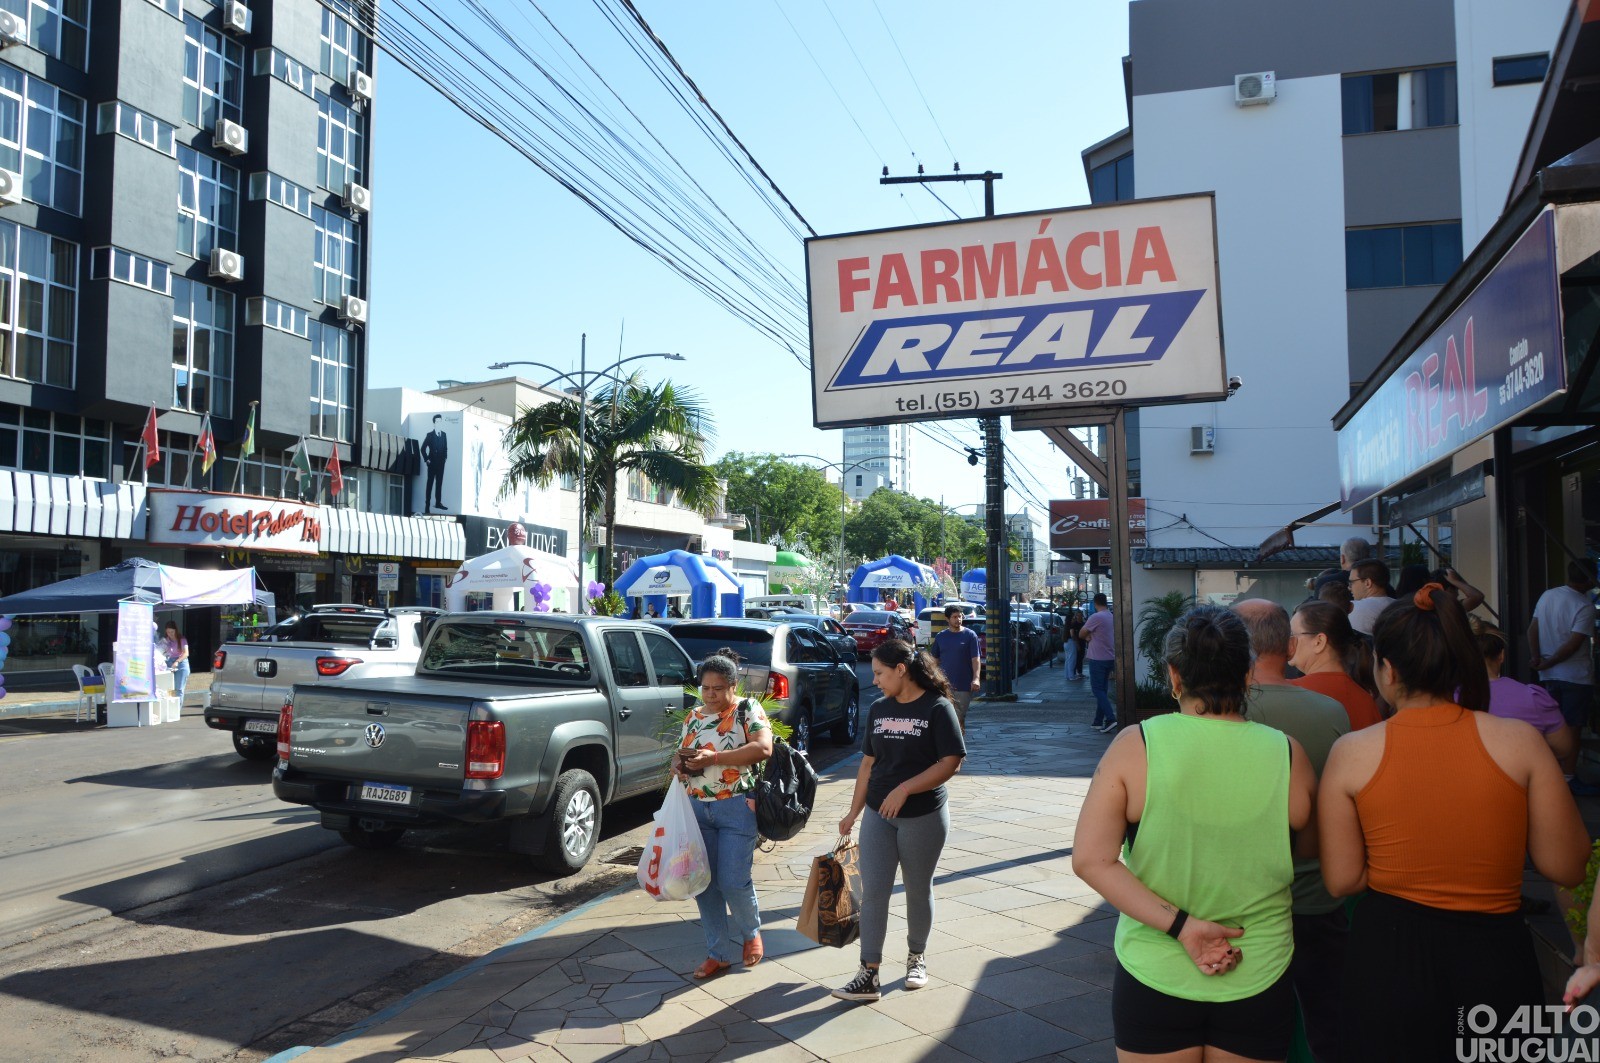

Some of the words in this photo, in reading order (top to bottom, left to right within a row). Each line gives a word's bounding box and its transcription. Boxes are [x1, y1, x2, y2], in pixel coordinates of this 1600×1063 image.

[837, 218, 1178, 313] FARMÁCIA
[858, 303, 1155, 378] REAL
[1510, 338, 1528, 366] Contato
[1405, 316, 1488, 461] REAL
[1506, 352, 1544, 401] 3744-3620
[896, 389, 980, 414] tel.(55)
[990, 387, 1053, 406] 3744
[1062, 378, 1126, 399] 3620
[169, 505, 253, 537] Hotel
[255, 509, 305, 538] Palace
[1051, 515, 1146, 534] Confiça
[487, 526, 557, 555] EXUTIVE
[365, 786, 407, 802] RAJ2G89
